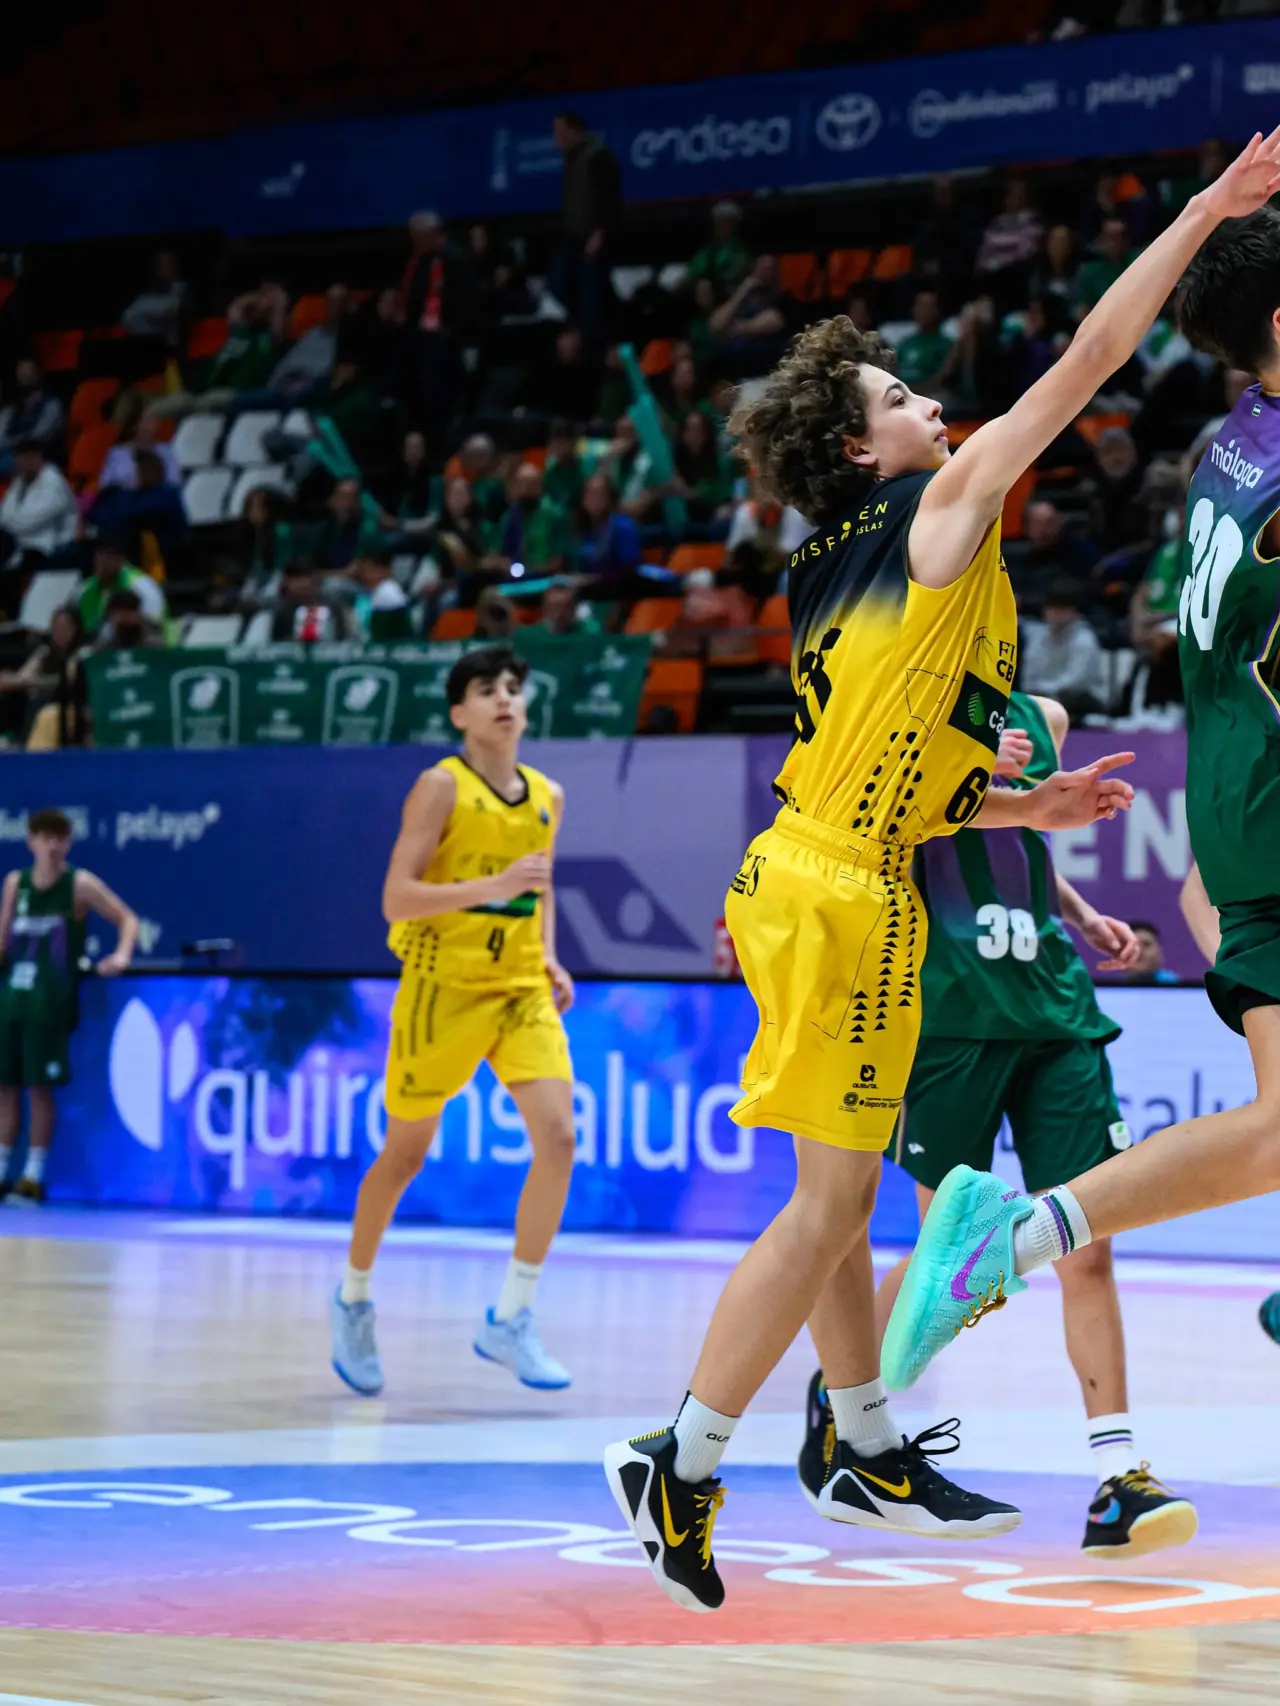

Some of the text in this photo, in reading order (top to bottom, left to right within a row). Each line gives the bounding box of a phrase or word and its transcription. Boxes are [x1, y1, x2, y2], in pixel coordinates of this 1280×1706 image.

[630, 114, 792, 170] endesa
[1211, 439, 1264, 491] málaga
[988, 707, 1008, 735] Ca
[943, 766, 990, 827] 6
[487, 926, 506, 964] 4
[975, 902, 1040, 963] 38
